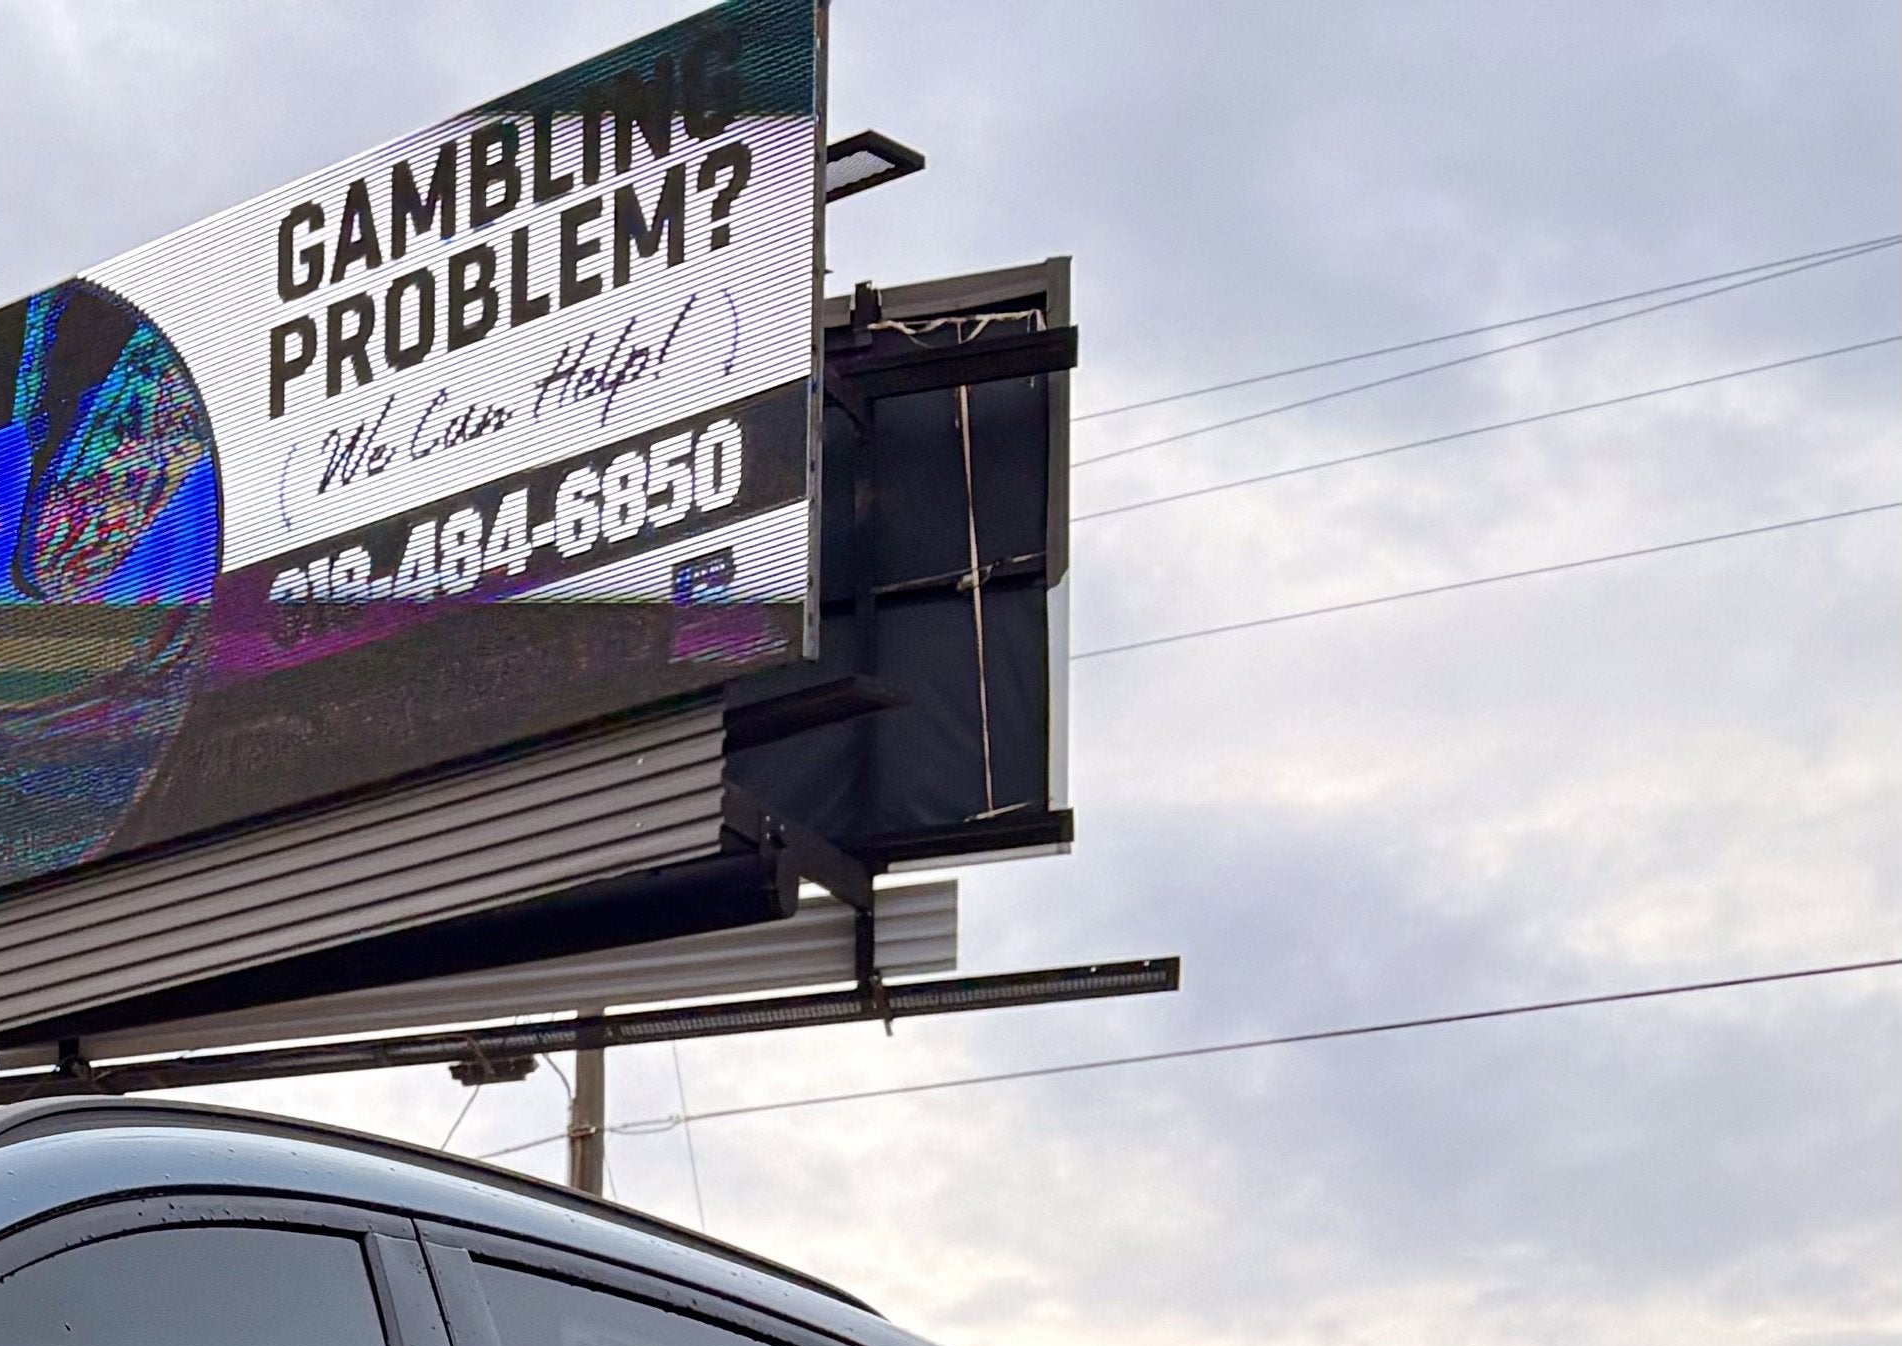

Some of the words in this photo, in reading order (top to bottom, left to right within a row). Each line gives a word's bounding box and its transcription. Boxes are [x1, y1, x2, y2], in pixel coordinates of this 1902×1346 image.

[270, 142, 752, 419] PROBLEM?
[278, 20, 742, 302] GAMBLING
[408, 389, 514, 457] Can
